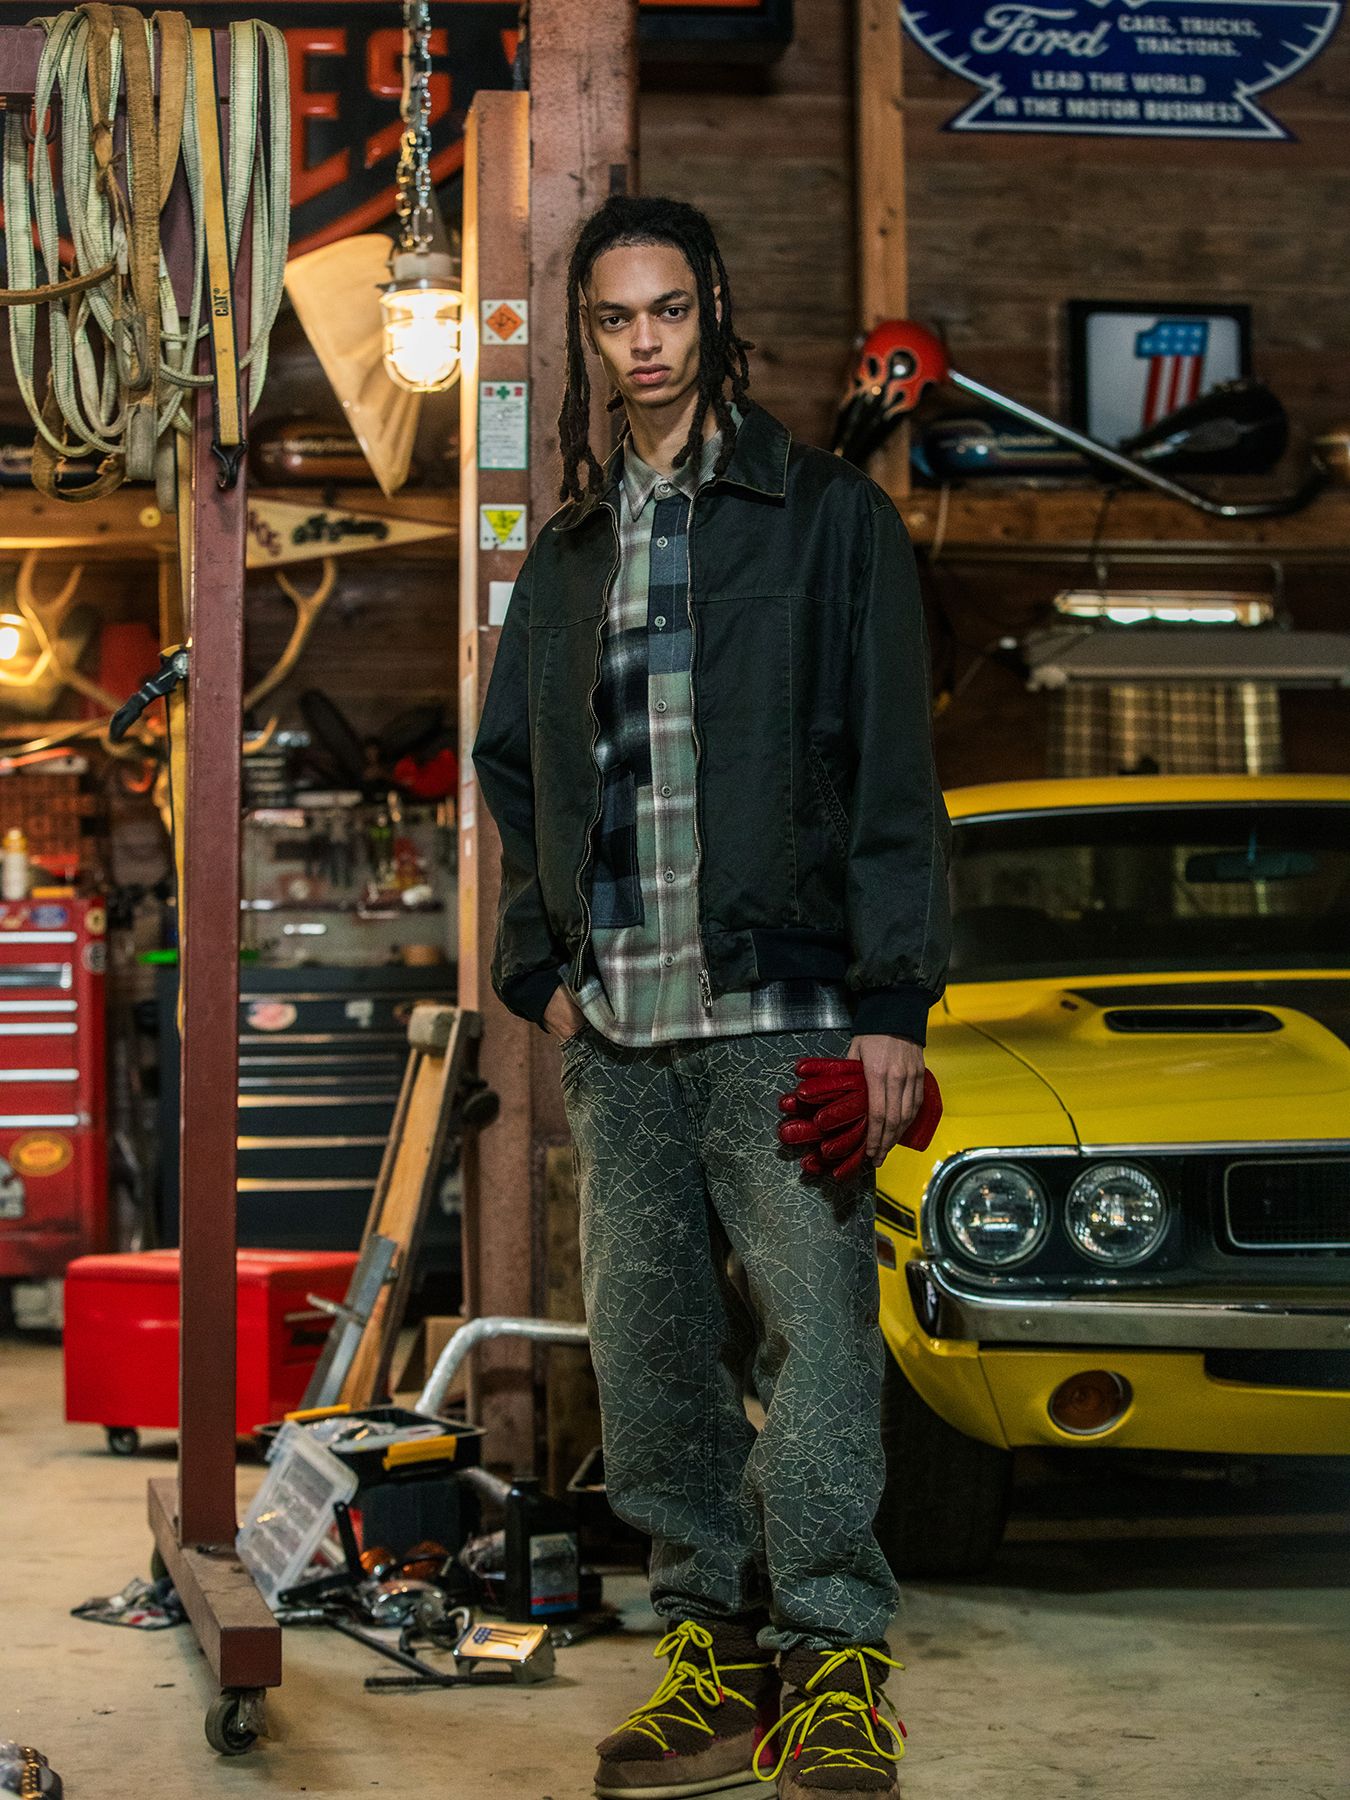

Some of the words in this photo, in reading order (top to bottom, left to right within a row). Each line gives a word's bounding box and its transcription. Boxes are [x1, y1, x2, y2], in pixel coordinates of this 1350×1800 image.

[970, 4, 1112, 58] Ford
[1117, 14, 1177, 35] CARS,
[1180, 16, 1263, 39] TRUCKS,
[1135, 36, 1242, 57] TRACTORS.
[1031, 71, 1085, 91] LEAD
[1088, 72, 1129, 93] THE
[1131, 73, 1206, 95] WORLD
[994, 97, 1018, 116] IN
[1022, 97, 1063, 118] THE
[1065, 99, 1141, 119] MOTOR
[1143, 101, 1244, 123] BUSINESS
